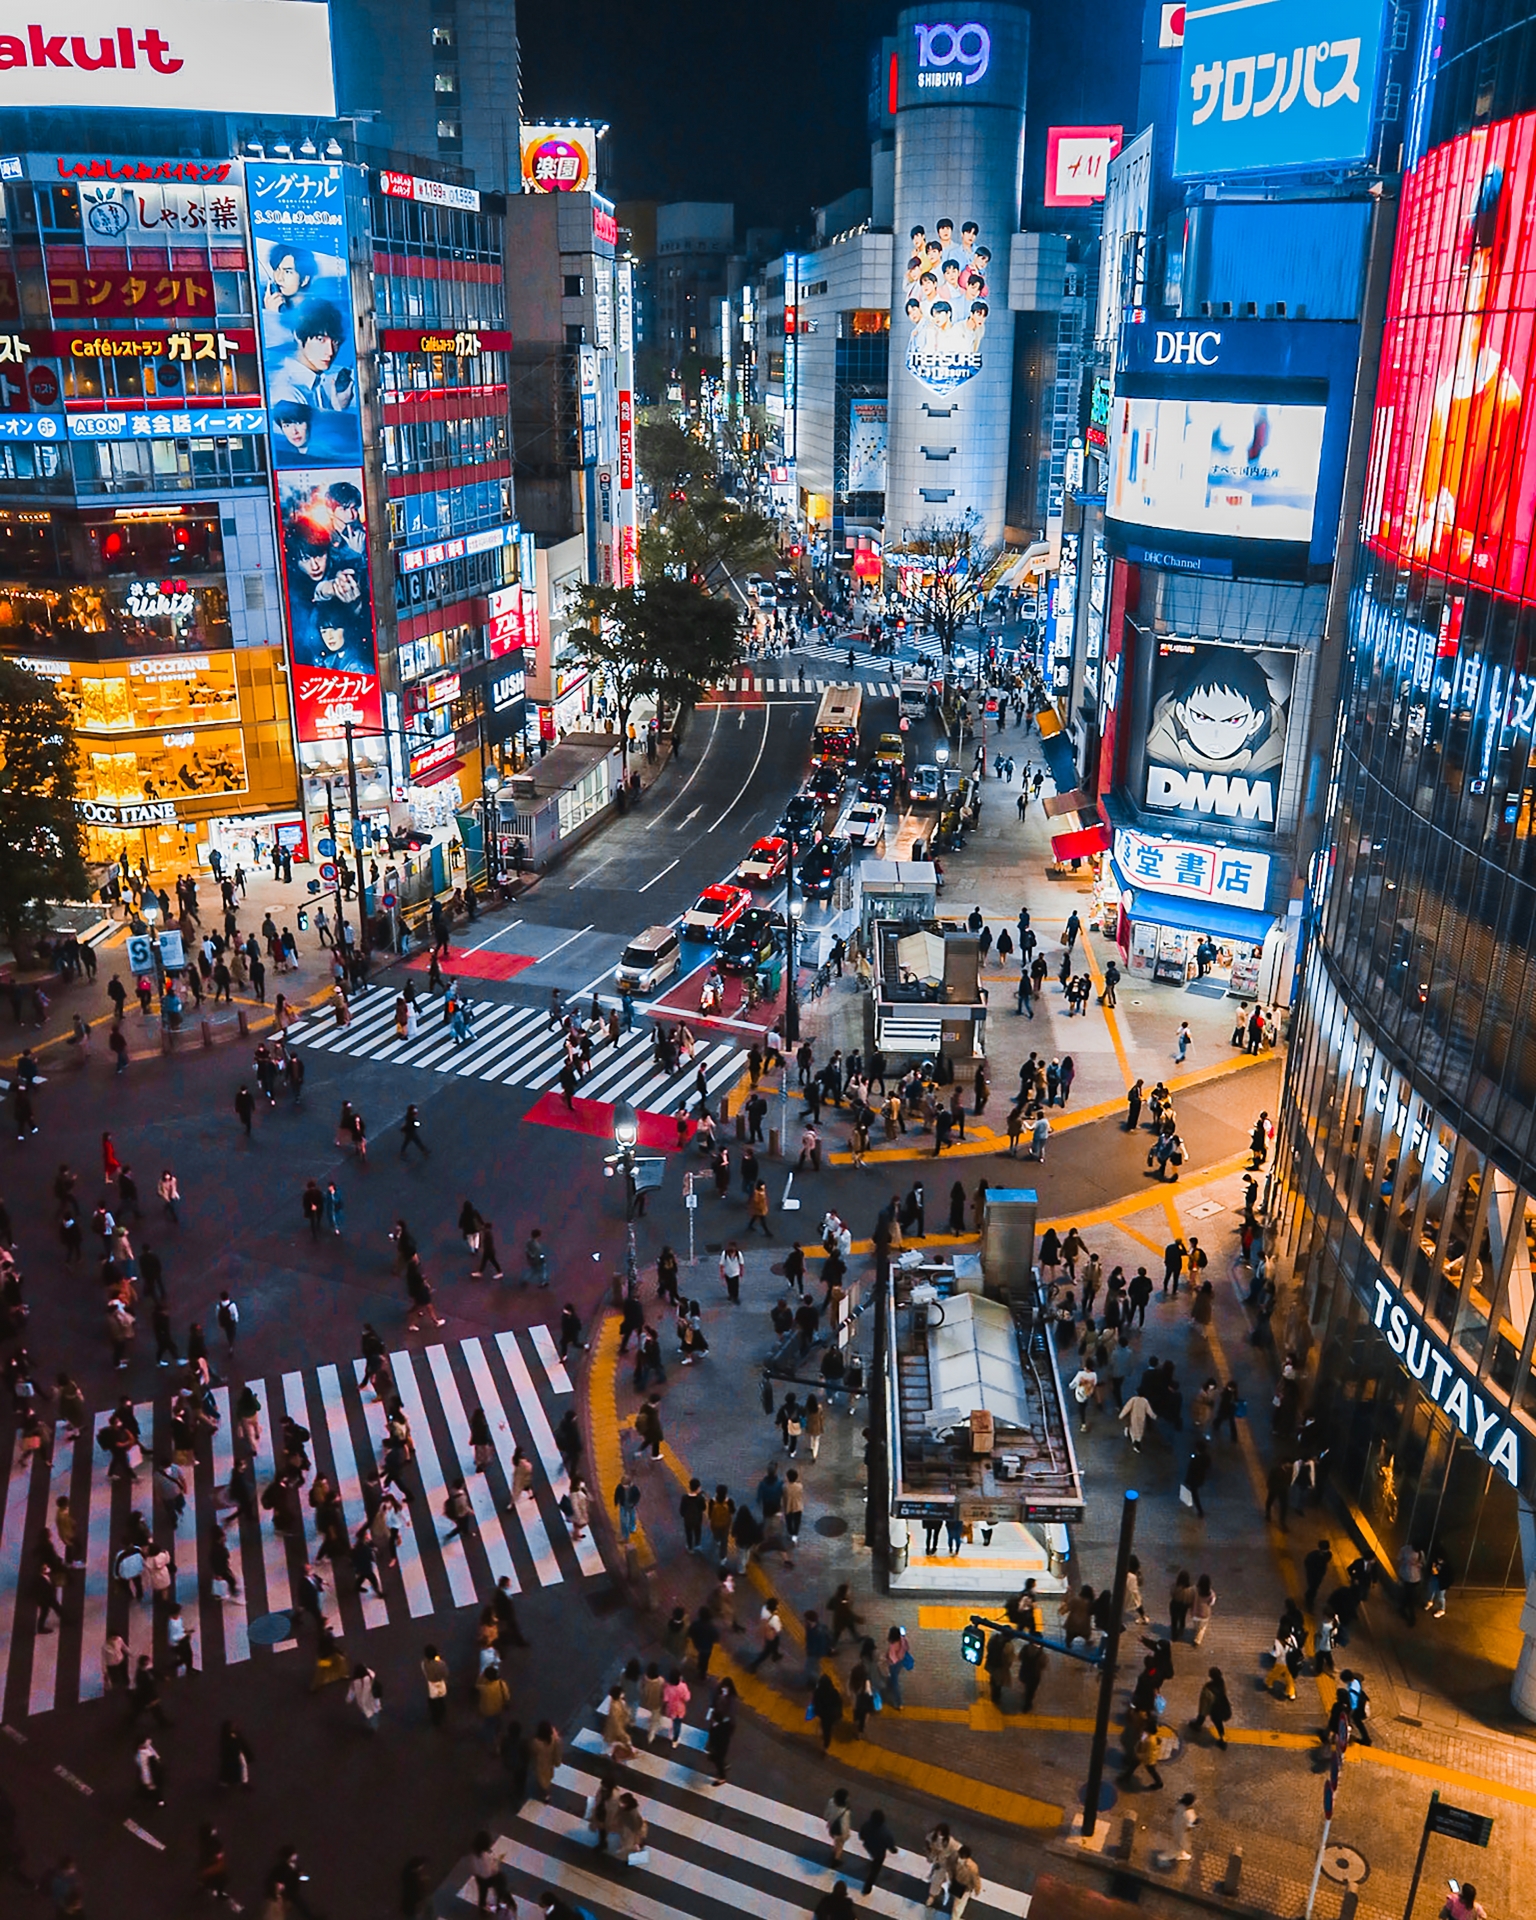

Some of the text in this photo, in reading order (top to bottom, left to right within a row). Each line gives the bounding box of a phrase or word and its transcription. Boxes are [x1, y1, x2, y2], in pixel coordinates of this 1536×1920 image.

[914, 22, 991, 85] 109
[917, 71, 963, 88] SHIBUYA
[1191, 37, 1362, 126] サロンパス
[57, 157, 232, 182] しゃぶしゃぶバイキング
[254, 173, 338, 199] シグナル
[138, 196, 238, 229] しゃぶ葉
[52, 277, 208, 306] コンタクト
[168, 332, 239, 361] ガスト
[455, 333, 482, 356] ガスト
[1153, 331, 1221, 366] DHC
[909, 353, 981, 366] TREASURE
[75, 419, 122, 435] AEON
[131, 413, 264, 435] 英会話イーオン
[621, 430, 632, 480] TaxFree
[506, 523, 519, 543] 4F
[1144, 552, 1201, 570] DHC Channel
[130, 656, 210, 676] L'OCCITANE
[299, 676, 375, 701] シグナル
[493, 670, 525, 704] LUSH
[1145, 764, 1274, 822] DMM
[1372, 1279, 1519, 1488] TSUTAYA
